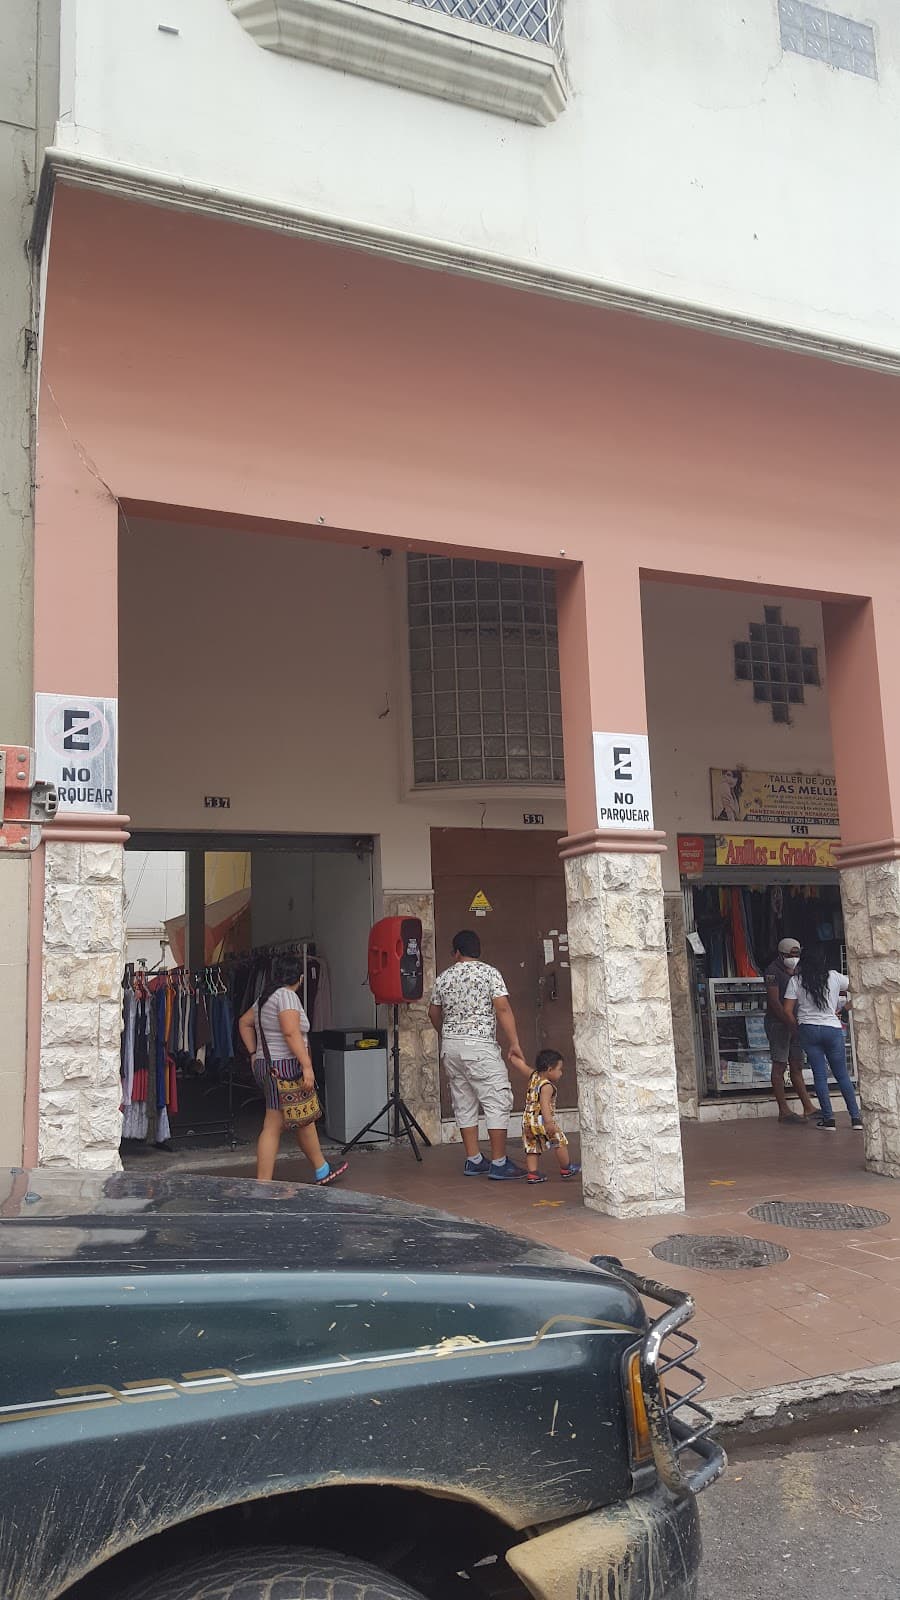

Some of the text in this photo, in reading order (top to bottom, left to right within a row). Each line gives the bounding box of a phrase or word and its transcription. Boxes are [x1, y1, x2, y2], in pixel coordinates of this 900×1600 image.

[62, 767, 90, 782] NO
[769, 775, 836, 786] TALLER DE JOY
[58, 787, 112, 804] RQUEAR
[799, 786, 838, 796] MELLIZ
[614, 792, 633, 805] NO
[601, 808, 649, 822] PARQUEAR
[725, 839, 768, 864] Anillos
[779, 841, 817, 865] Grado
